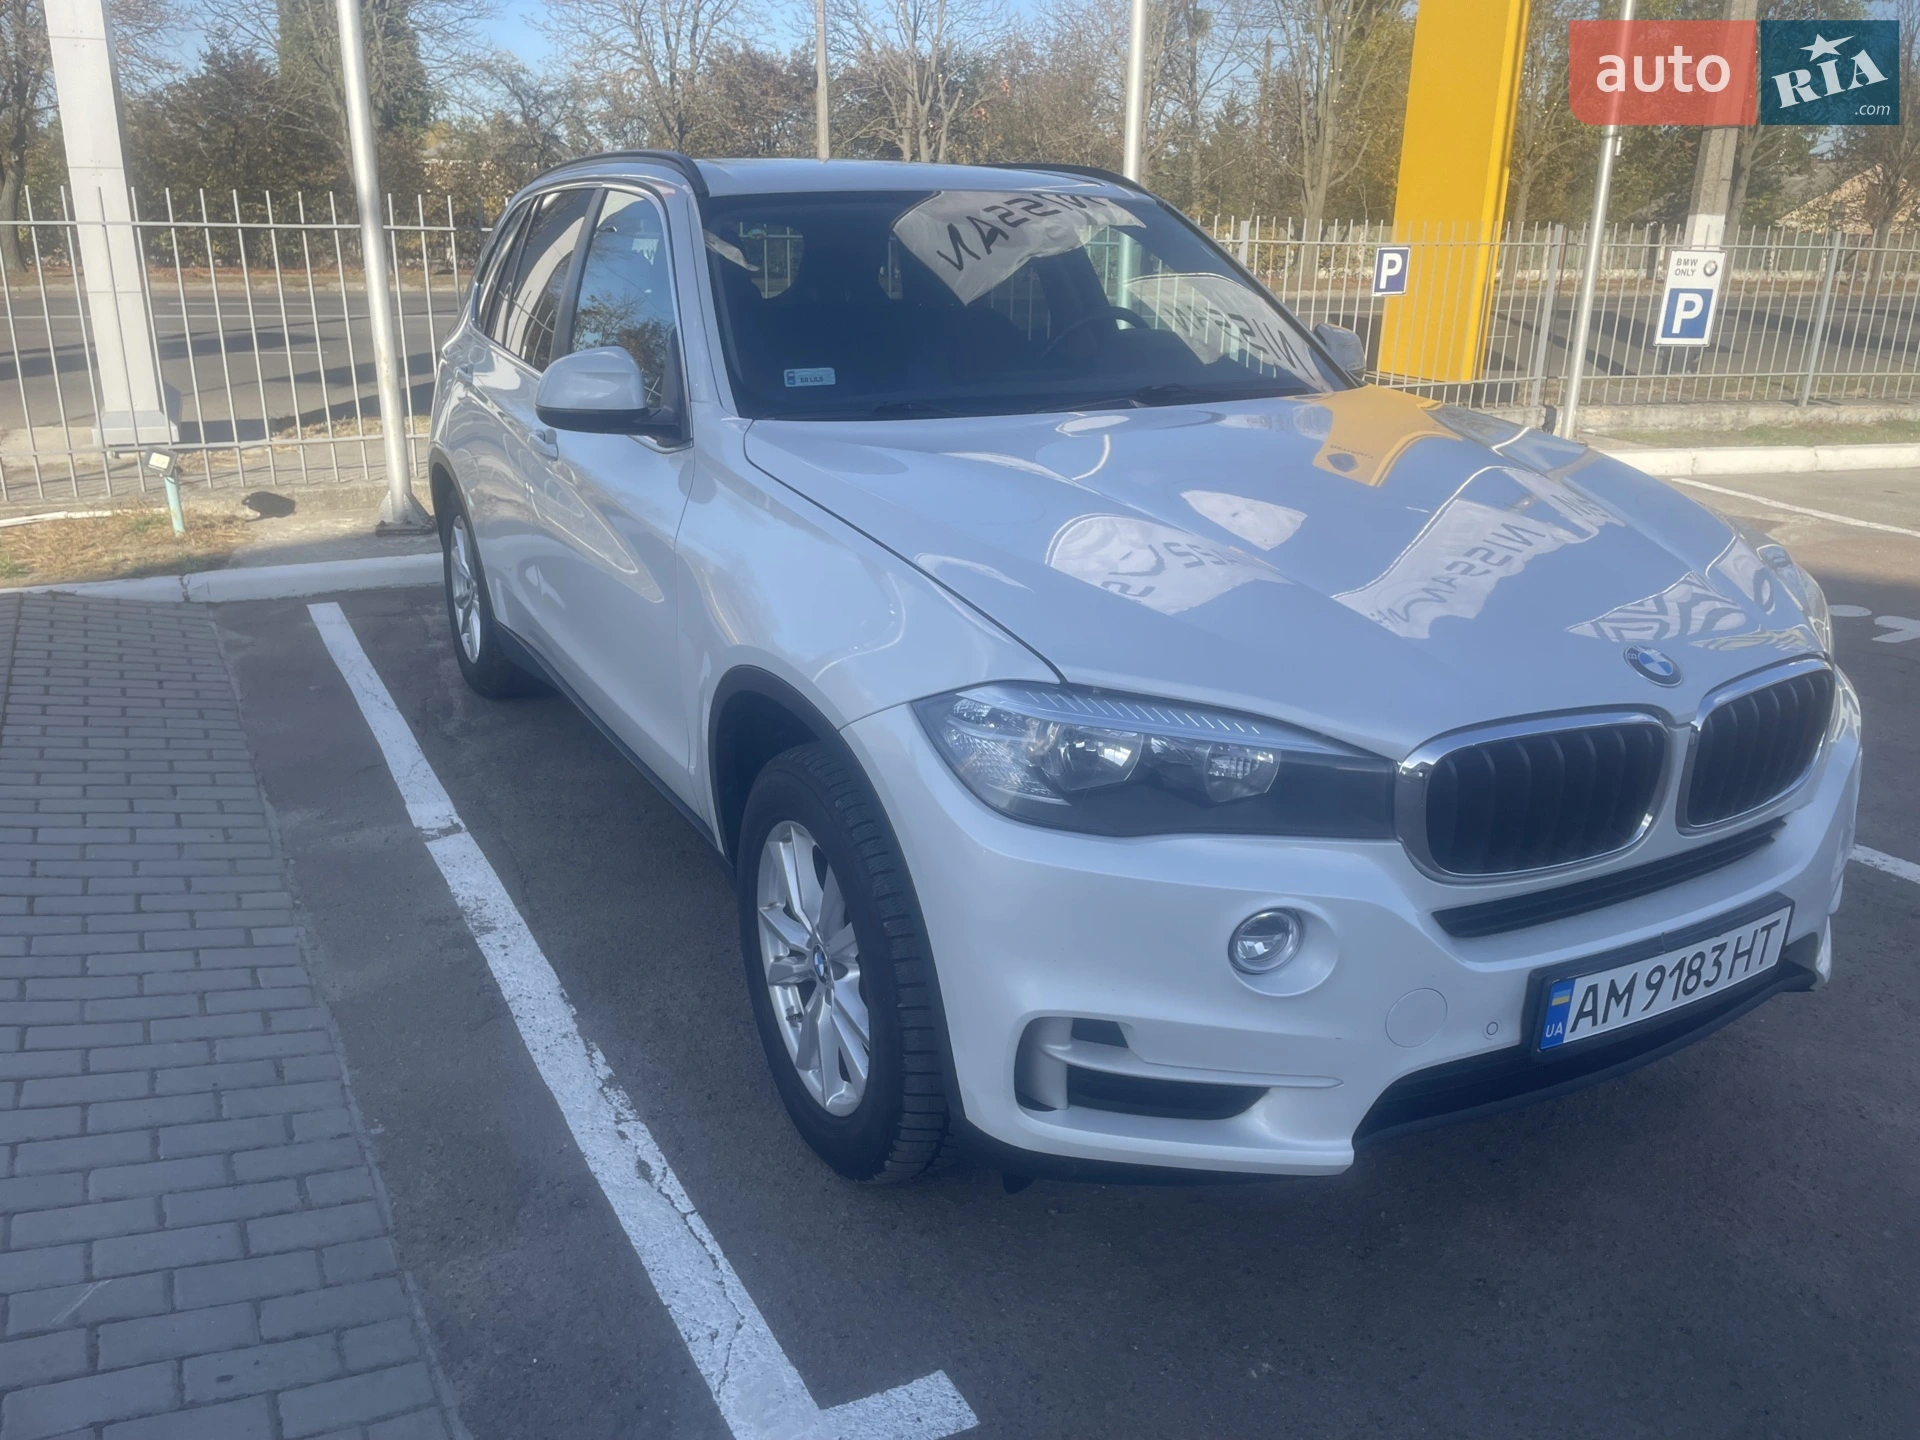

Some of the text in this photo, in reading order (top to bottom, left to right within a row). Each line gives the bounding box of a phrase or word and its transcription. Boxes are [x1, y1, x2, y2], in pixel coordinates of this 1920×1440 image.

[1379, 252, 1403, 289] P
[1676, 258, 1699, 266] BMW
[1674, 268, 1697, 277] ONLY
[1671, 292, 1704, 334] P
[1545, 1021, 1564, 1039] UA
